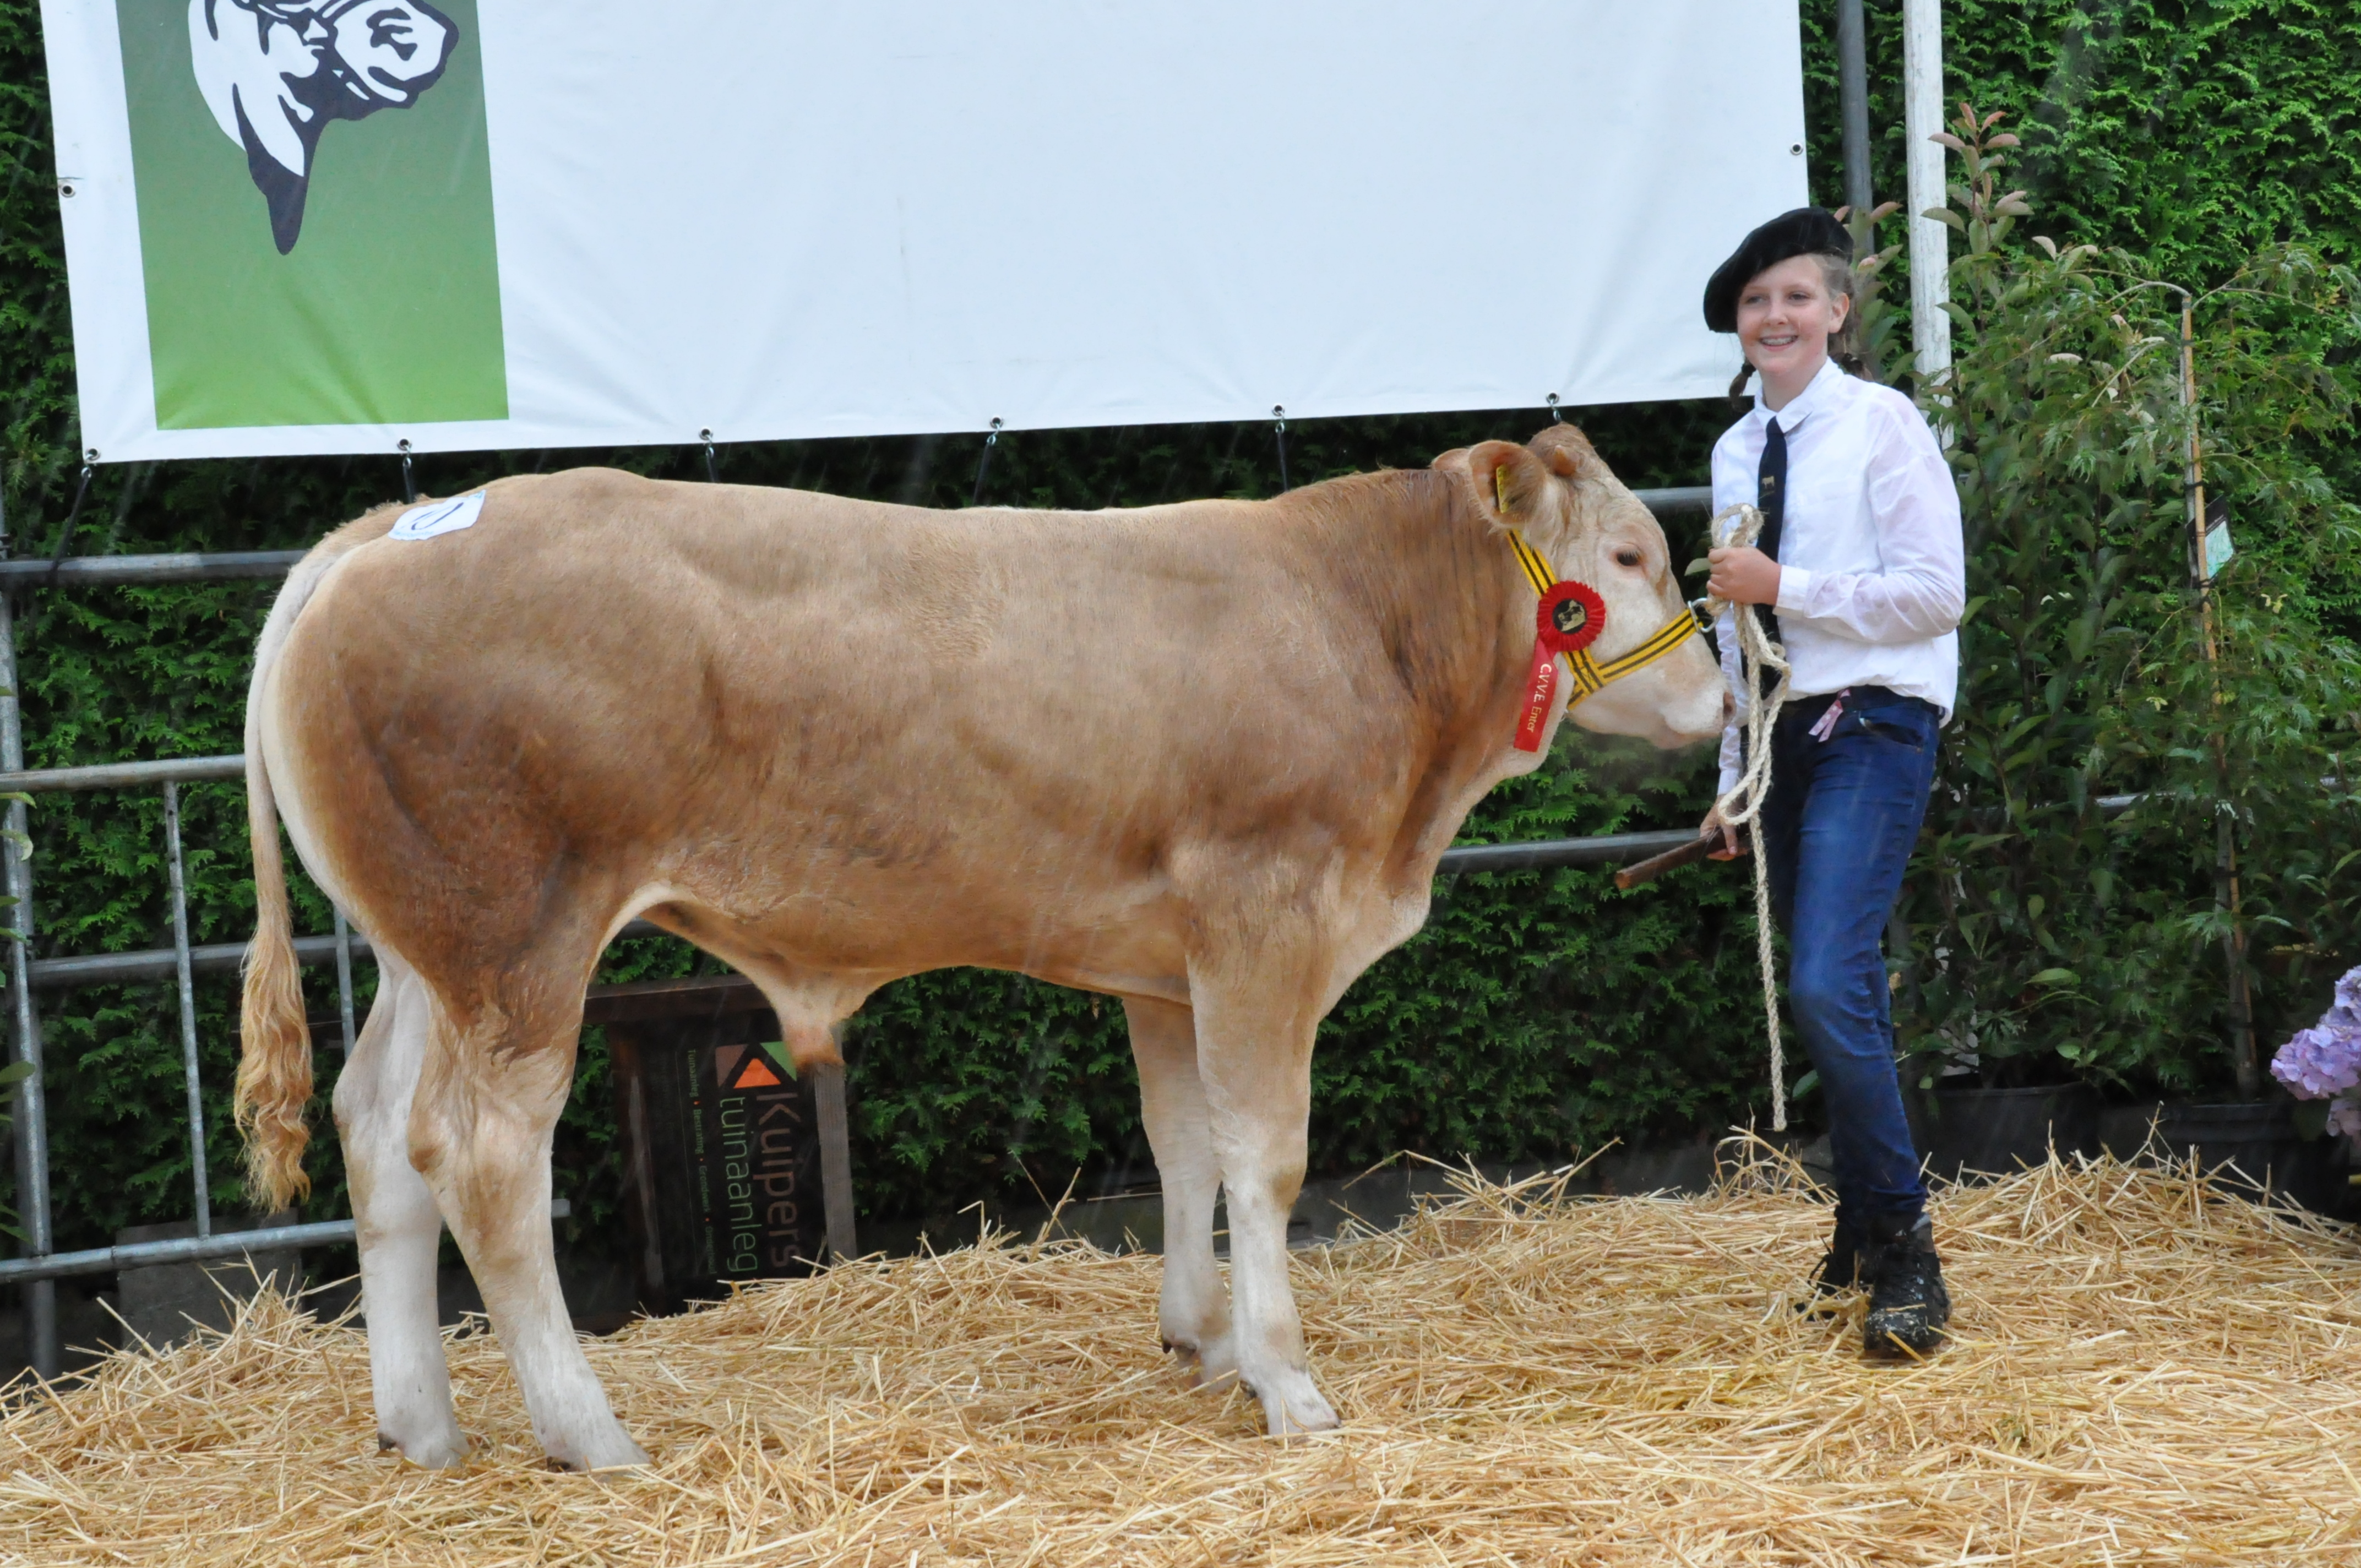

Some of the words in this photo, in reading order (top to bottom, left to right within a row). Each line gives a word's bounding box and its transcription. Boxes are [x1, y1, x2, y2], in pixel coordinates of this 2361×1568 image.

[1526, 706, 1541, 733] Enter
[688, 1049, 699, 1097] Tuinaanleg
[693, 1109, 705, 1154] Bestrating
[699, 1166, 710, 1213] Grondwerk
[717, 1096, 762, 1273] tuinaanleg
[753, 1093, 802, 1268] Kuipers
[705, 1226, 717, 1275] Onderhoud
